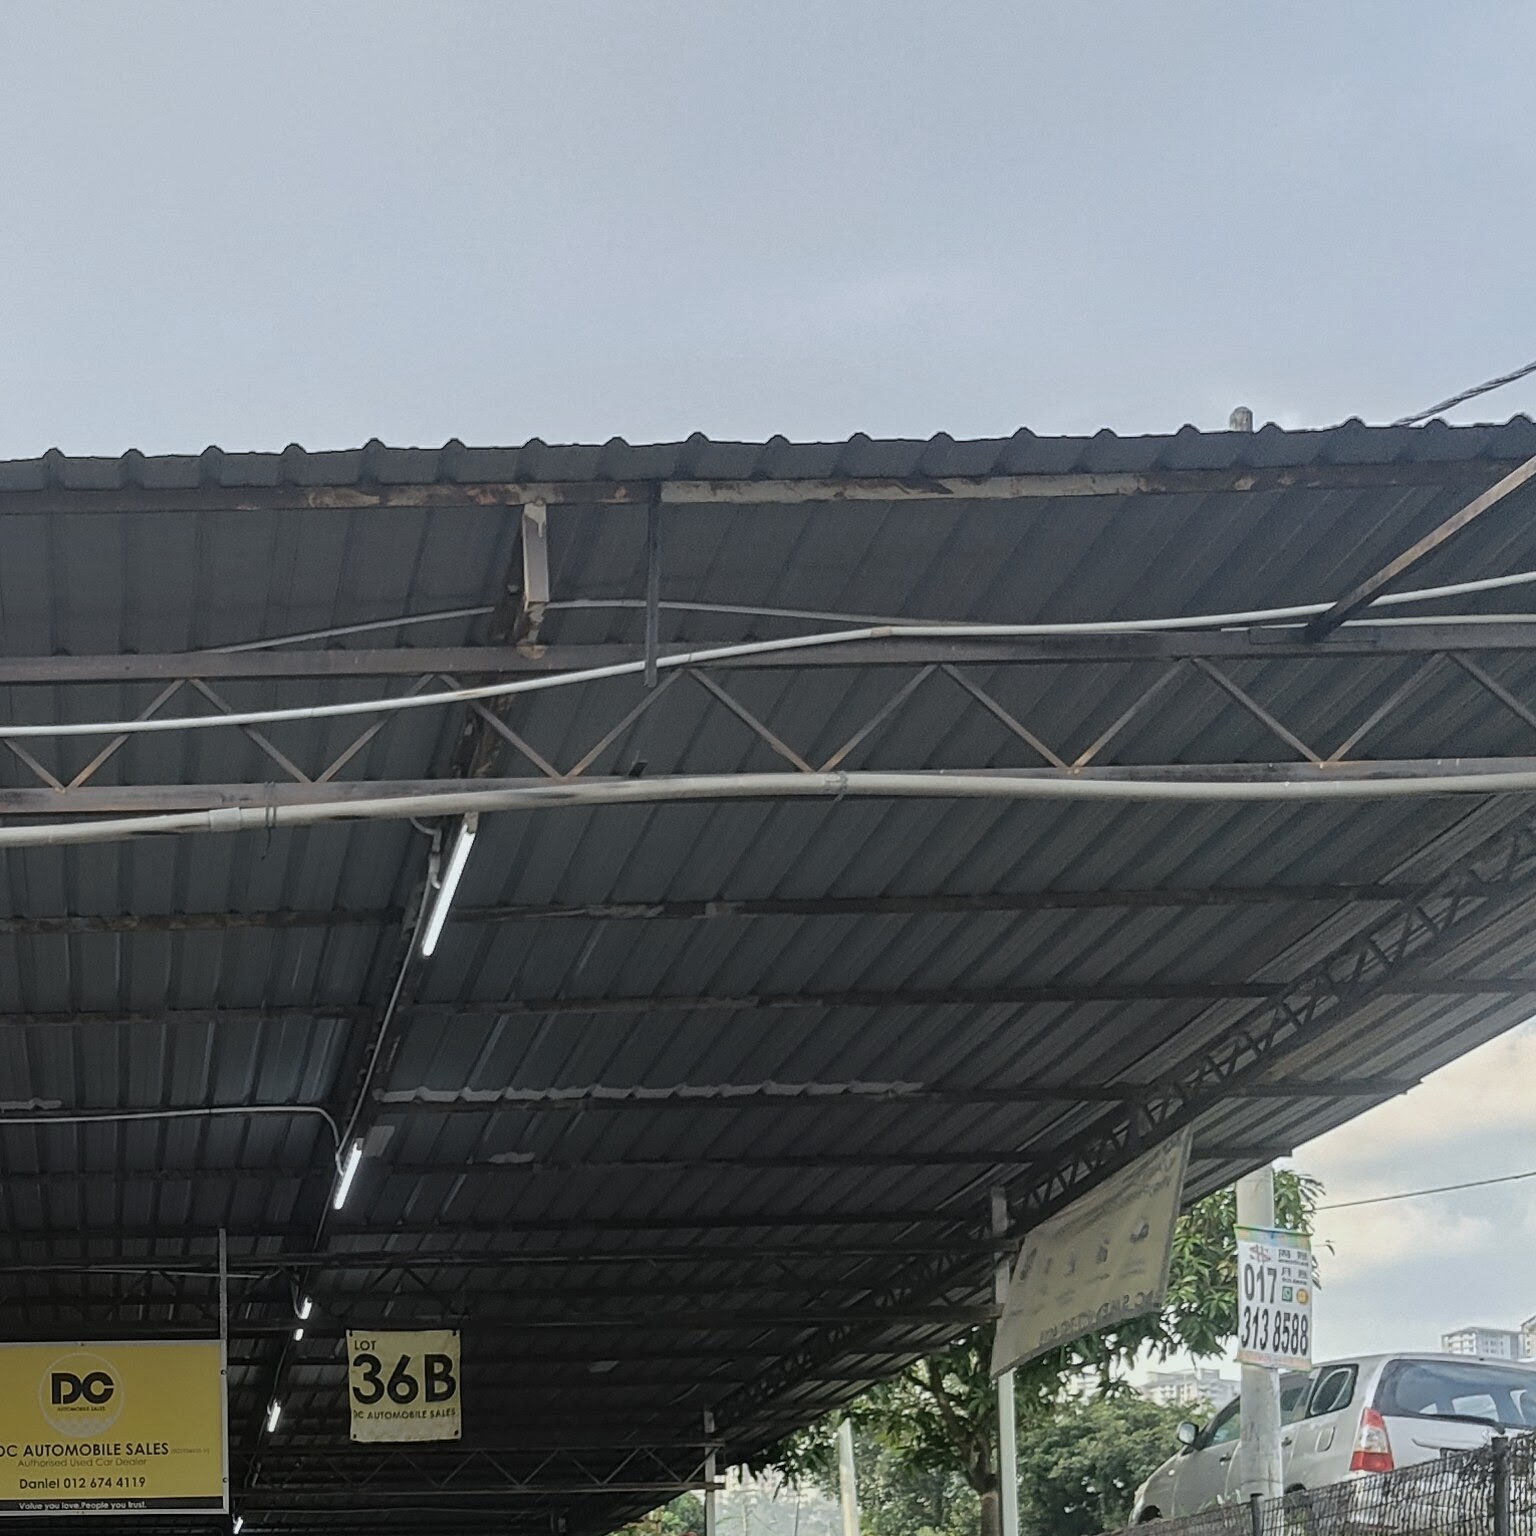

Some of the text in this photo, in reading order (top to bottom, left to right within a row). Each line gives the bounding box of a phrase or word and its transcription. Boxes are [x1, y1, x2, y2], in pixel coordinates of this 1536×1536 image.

[1244, 1263, 1277, 1304] 017
[1241, 1306, 1309, 1356] 313 8588
[354, 1340, 376, 1351] LOT
[352, 1353, 456, 1405] 36B
[51, 1371, 114, 1405] DC
[367, 1410, 427, 1420] AUTOMOBILE
[430, 1408, 456, 1418] SALES
[23, 1443, 121, 1457] AUTOMOBILE
[126, 1442, 169, 1456] SALES
[17, 1457, 147, 1468] Authorised Used Car Dealer
[19, 1477, 146, 1489] Daniel 012 674 4119
[18, 1502, 43, 1510] Value
[44, 1503, 60, 1511] you
[110, 1502, 126, 1510] you
